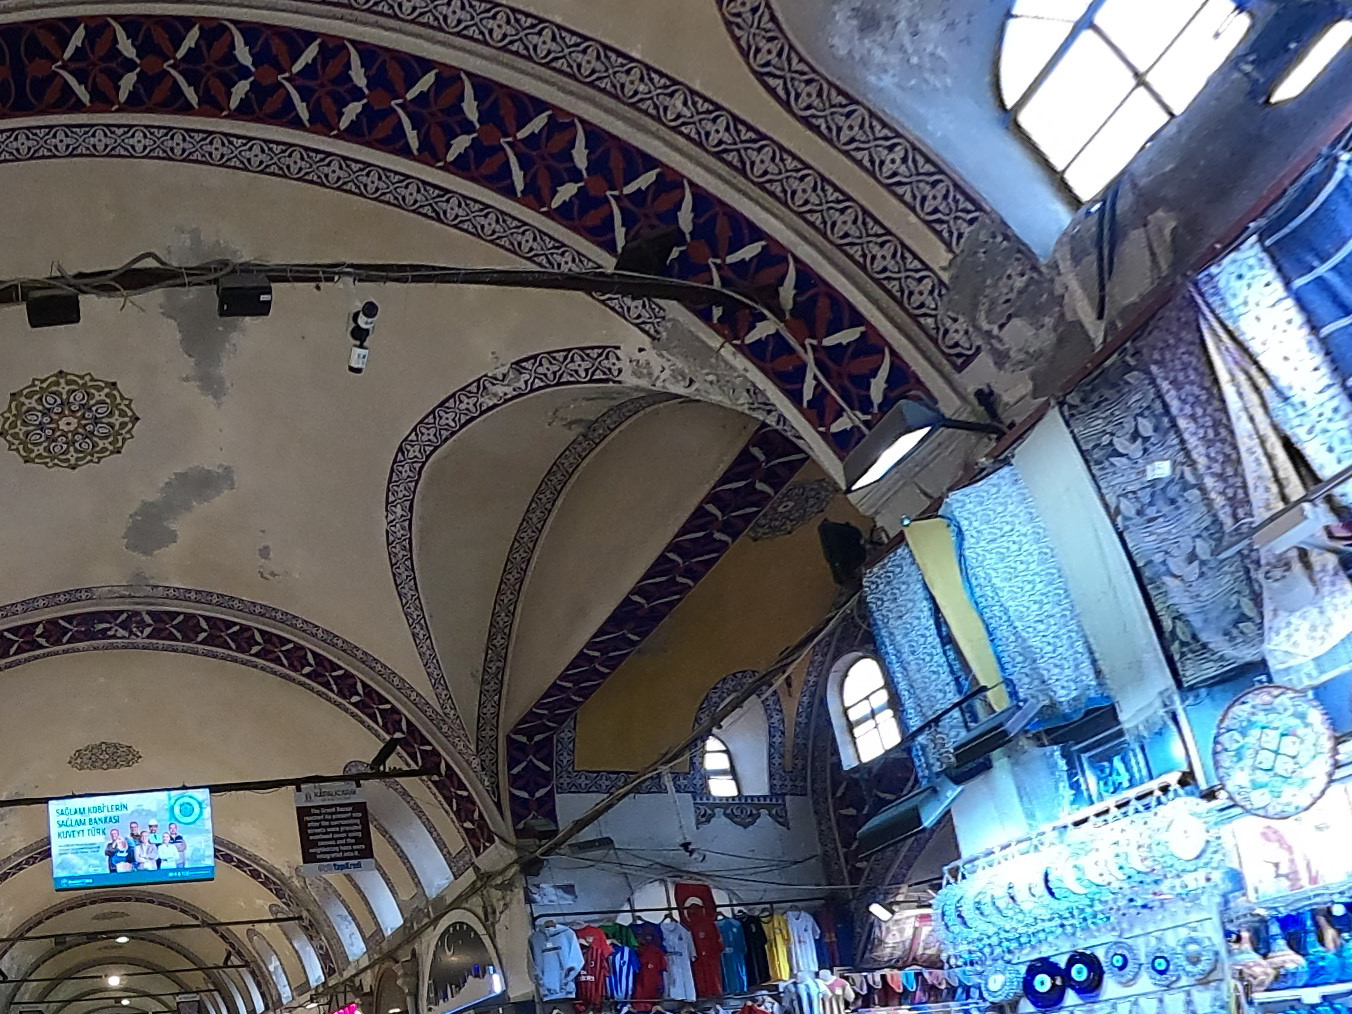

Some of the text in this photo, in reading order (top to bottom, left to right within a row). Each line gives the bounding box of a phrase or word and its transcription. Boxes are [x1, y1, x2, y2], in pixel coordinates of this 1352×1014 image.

[55, 806, 86, 817] SAĞLAM
[56, 815, 120, 828] SAĞLAM BANKASI
[57, 829, 85, 839] KUVEYT
